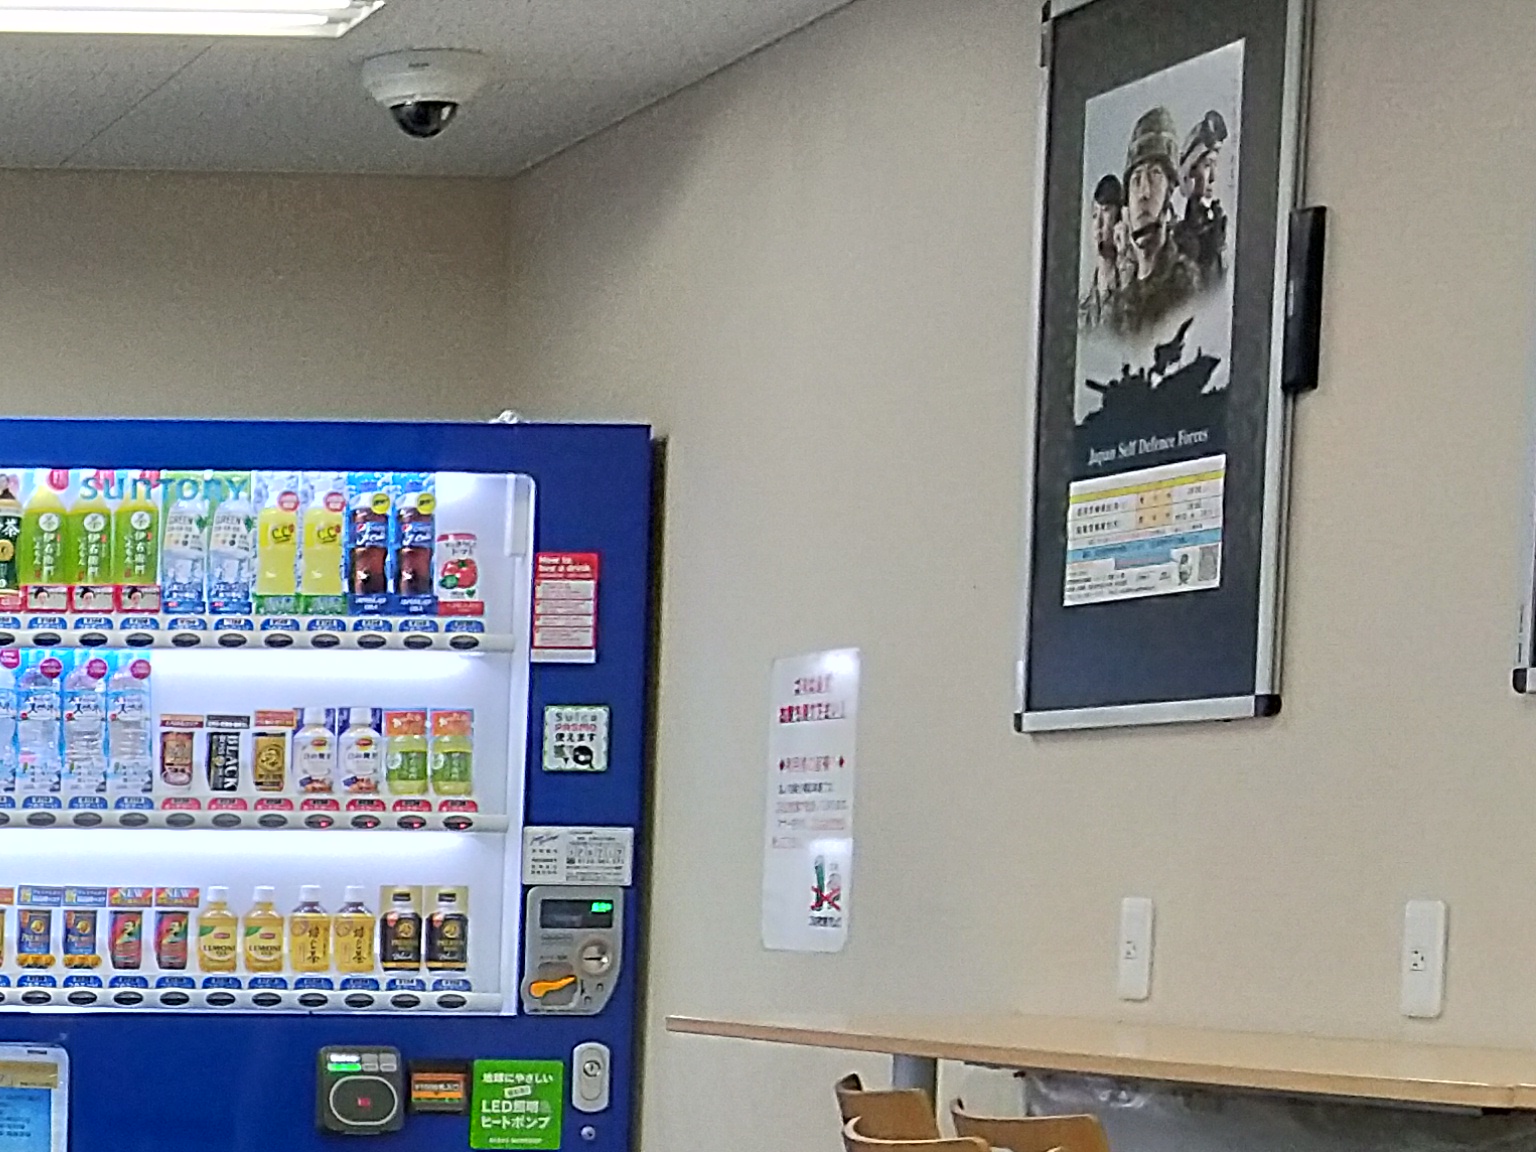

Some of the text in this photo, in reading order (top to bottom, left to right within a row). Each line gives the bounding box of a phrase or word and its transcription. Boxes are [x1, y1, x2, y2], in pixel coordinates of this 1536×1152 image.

[1088, 428, 1209, 467] Japan Self Defence Forces
[554, 712, 598, 722] Suica
[554, 723, 598, 732] PASMO
[554, 733, 597, 742] 使えます
[223, 734, 239, 789] BLACK
[482, 1072, 554, 1084] 地球にやさしい
[481, 1115, 551, 1130] ヒートポンプ
